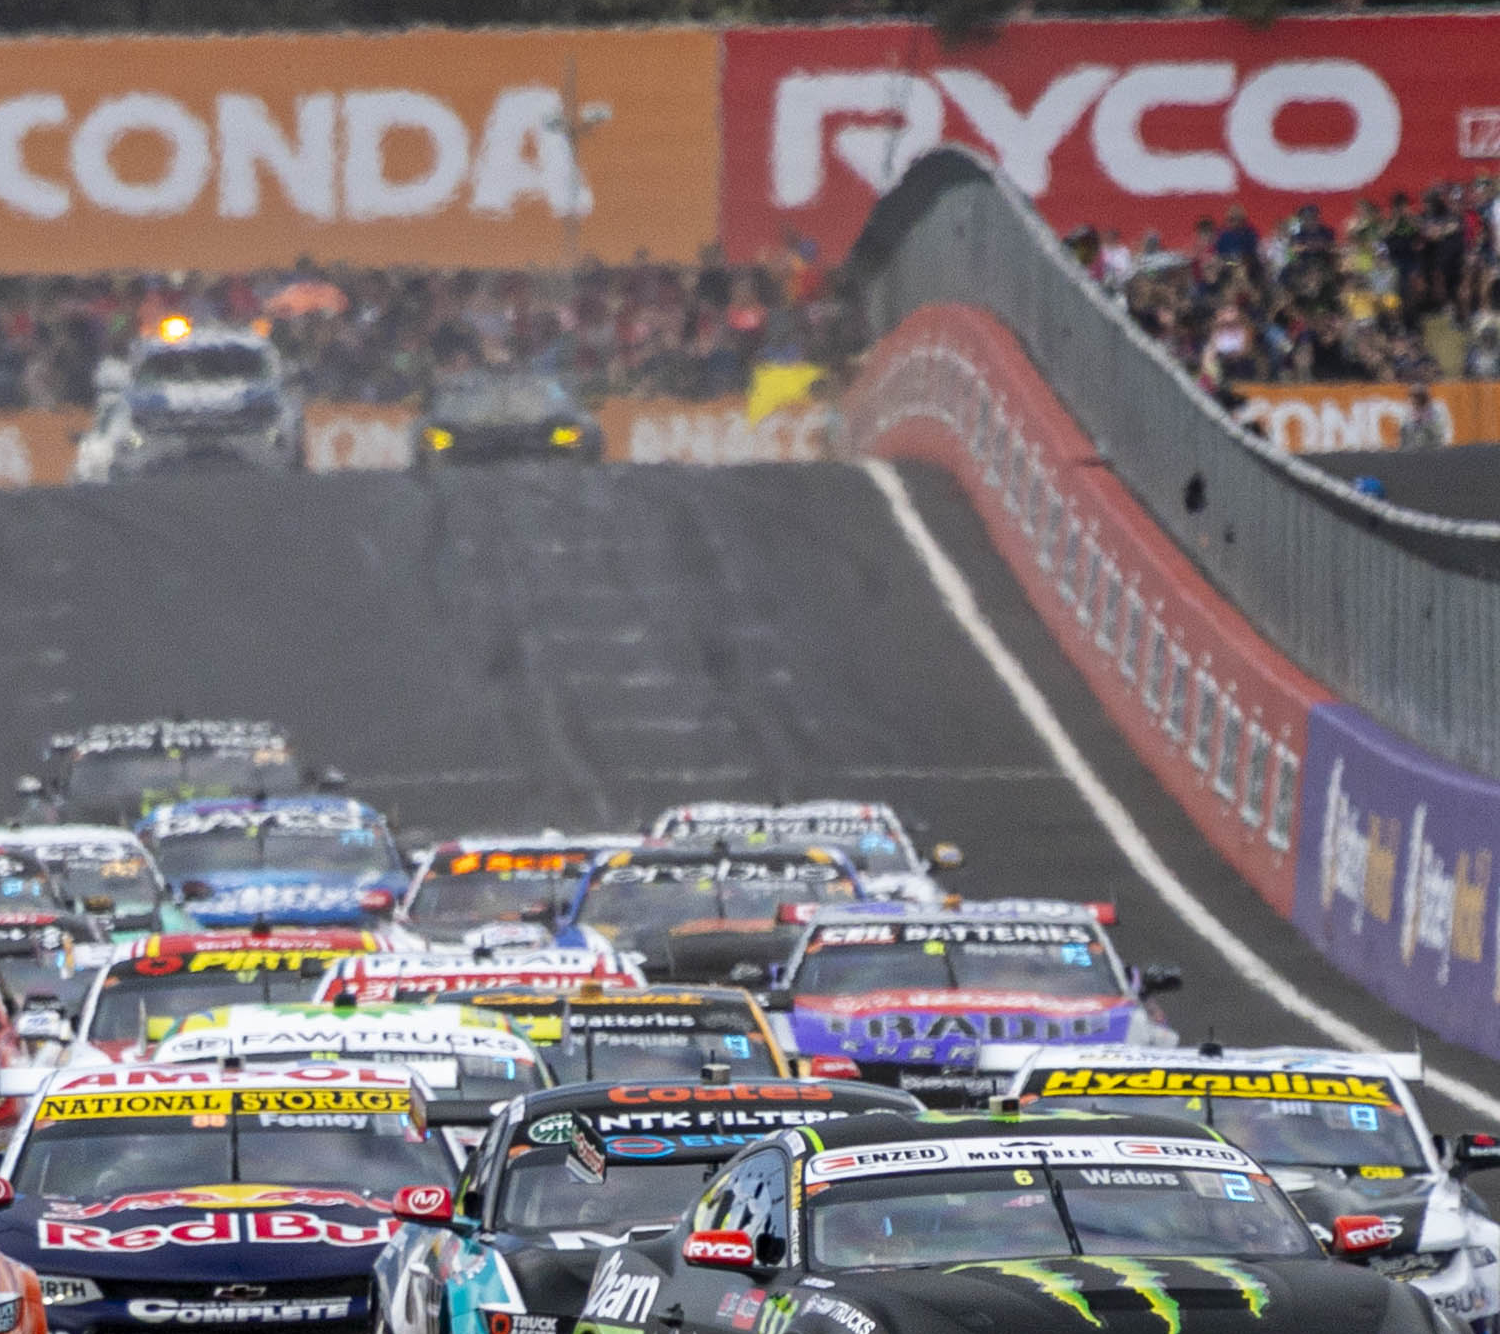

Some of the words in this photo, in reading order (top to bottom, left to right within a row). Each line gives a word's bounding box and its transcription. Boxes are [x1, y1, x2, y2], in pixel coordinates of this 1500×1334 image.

[773, 58, 1402, 210] RYCO
[904, 924, 1090, 944] BATTERIES
[241, 1031, 341, 1047] FAW
[355, 1030, 519, 1052] TRUCKS
[59, 1066, 407, 1092] AMOL
[1043, 1068, 1388, 1105] Hydraulink
[45, 1093, 221, 1120] NATIONAL
[238, 1090, 412, 1115] STORAGE
[259, 1112, 370, 1131] Feeney
[600, 1112, 693, 1131] NTK
[856, 1146, 937, 1166] ENZED
[1163, 1143, 1236, 1164] ENZED
[1014, 1169, 1035, 1187] 6
[1080, 1168, 1179, 1187] Waters
[1221, 1172, 1256, 1203] 2
[38, 1212, 241, 1252] Red
[688, 1240, 753, 1258] RYCO
[127, 1298, 351, 1323] COMPLETE
[512, 1315, 559, 1332] TRUCK
